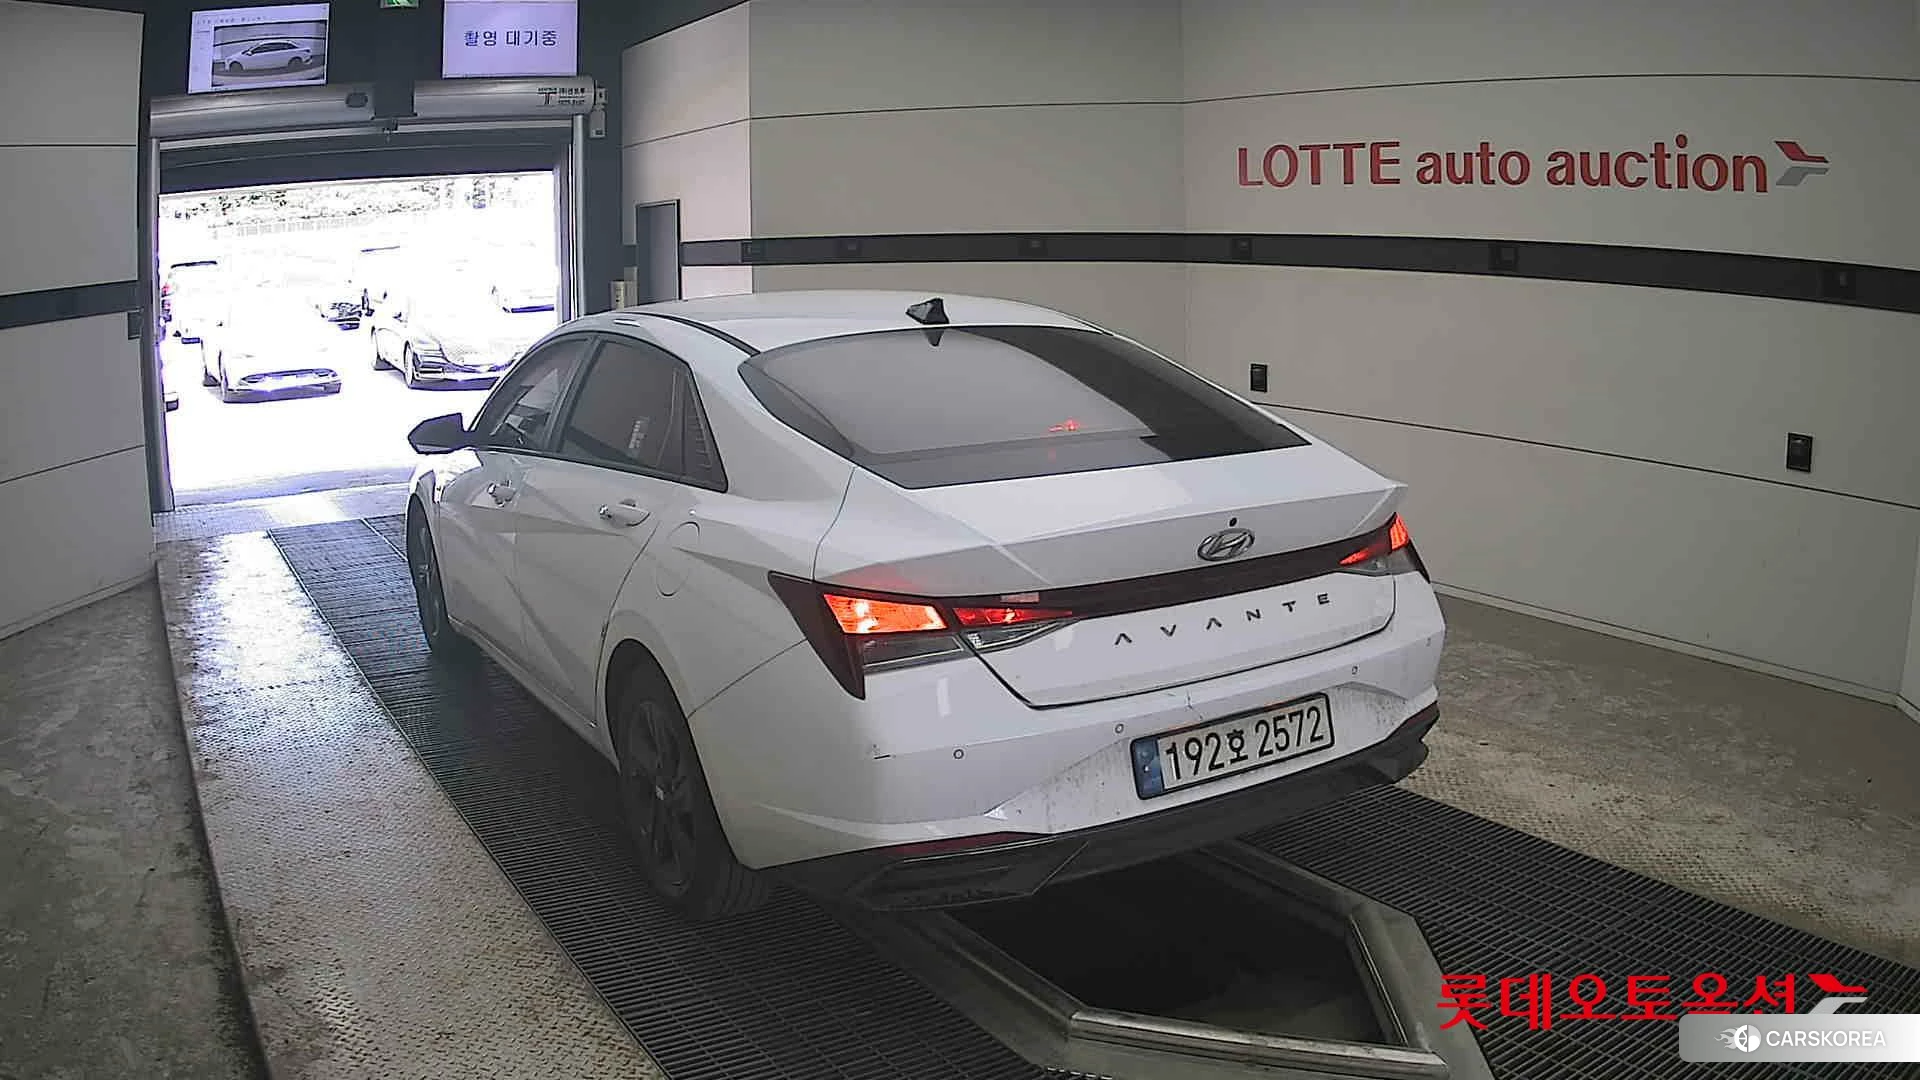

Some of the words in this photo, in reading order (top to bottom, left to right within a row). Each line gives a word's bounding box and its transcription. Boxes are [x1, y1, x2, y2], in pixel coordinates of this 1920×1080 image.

[505, 30, 558, 47] 대기중
[1238, 141, 1401, 188] LOTTE
[1416, 141, 1531, 185] auto
[1546, 134, 1768, 193] auction
[1114, 593, 1330, 646] AVANTE
[1165, 728, 1249, 781] 192호
[1254, 705, 1324, 759] 2572
